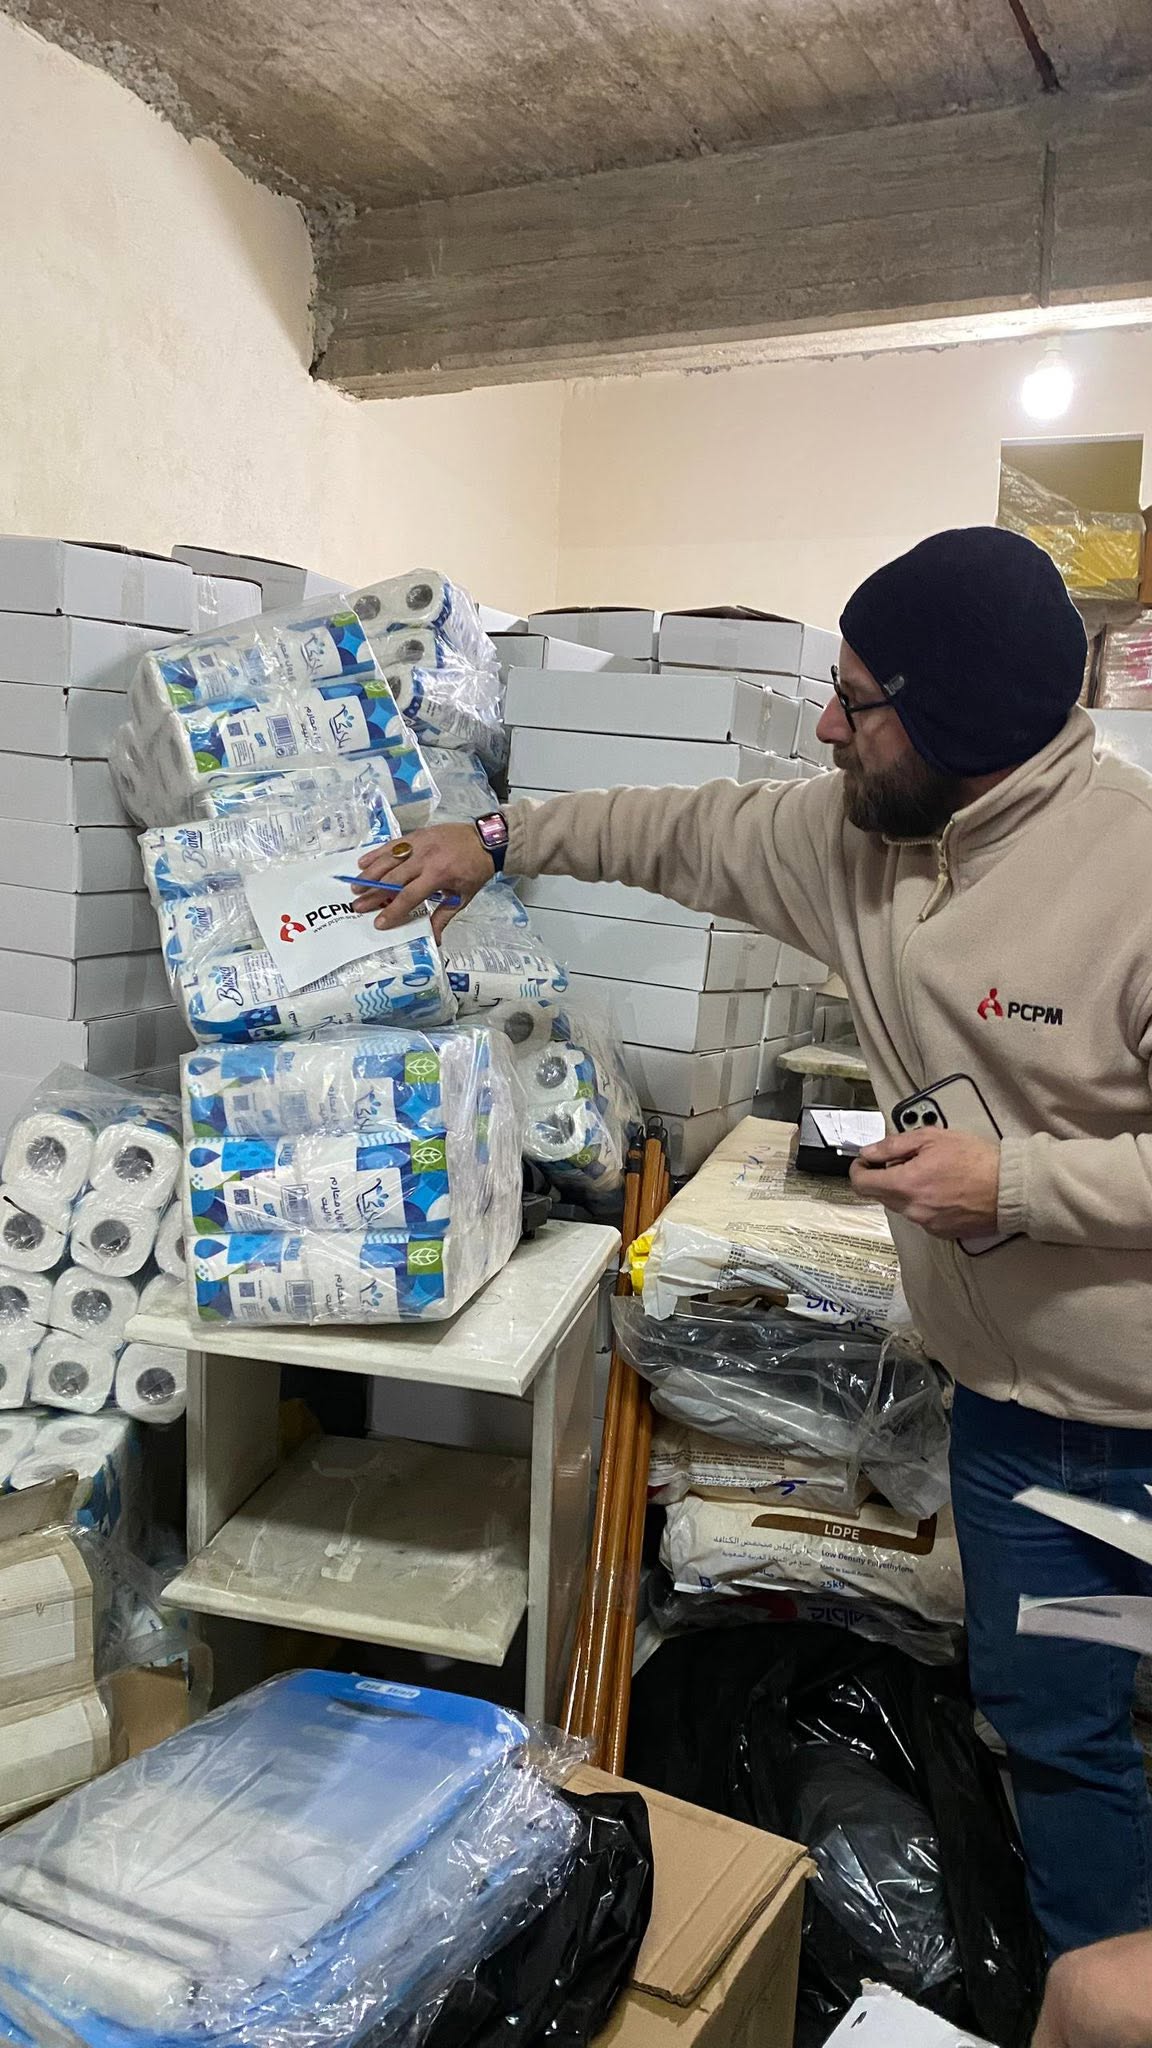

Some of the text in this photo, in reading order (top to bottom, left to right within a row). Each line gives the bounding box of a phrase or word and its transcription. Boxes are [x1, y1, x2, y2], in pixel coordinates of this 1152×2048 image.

[1008, 1002, 1063, 1025] PCPM
[330, 1177, 341, 1207] محارم
[824, 1523, 860, 1540] LDPE
[821, 1550, 836, 1559] Low
[838, 1553, 865, 1565] Density
[820, 1580, 845, 1590] 25kg
